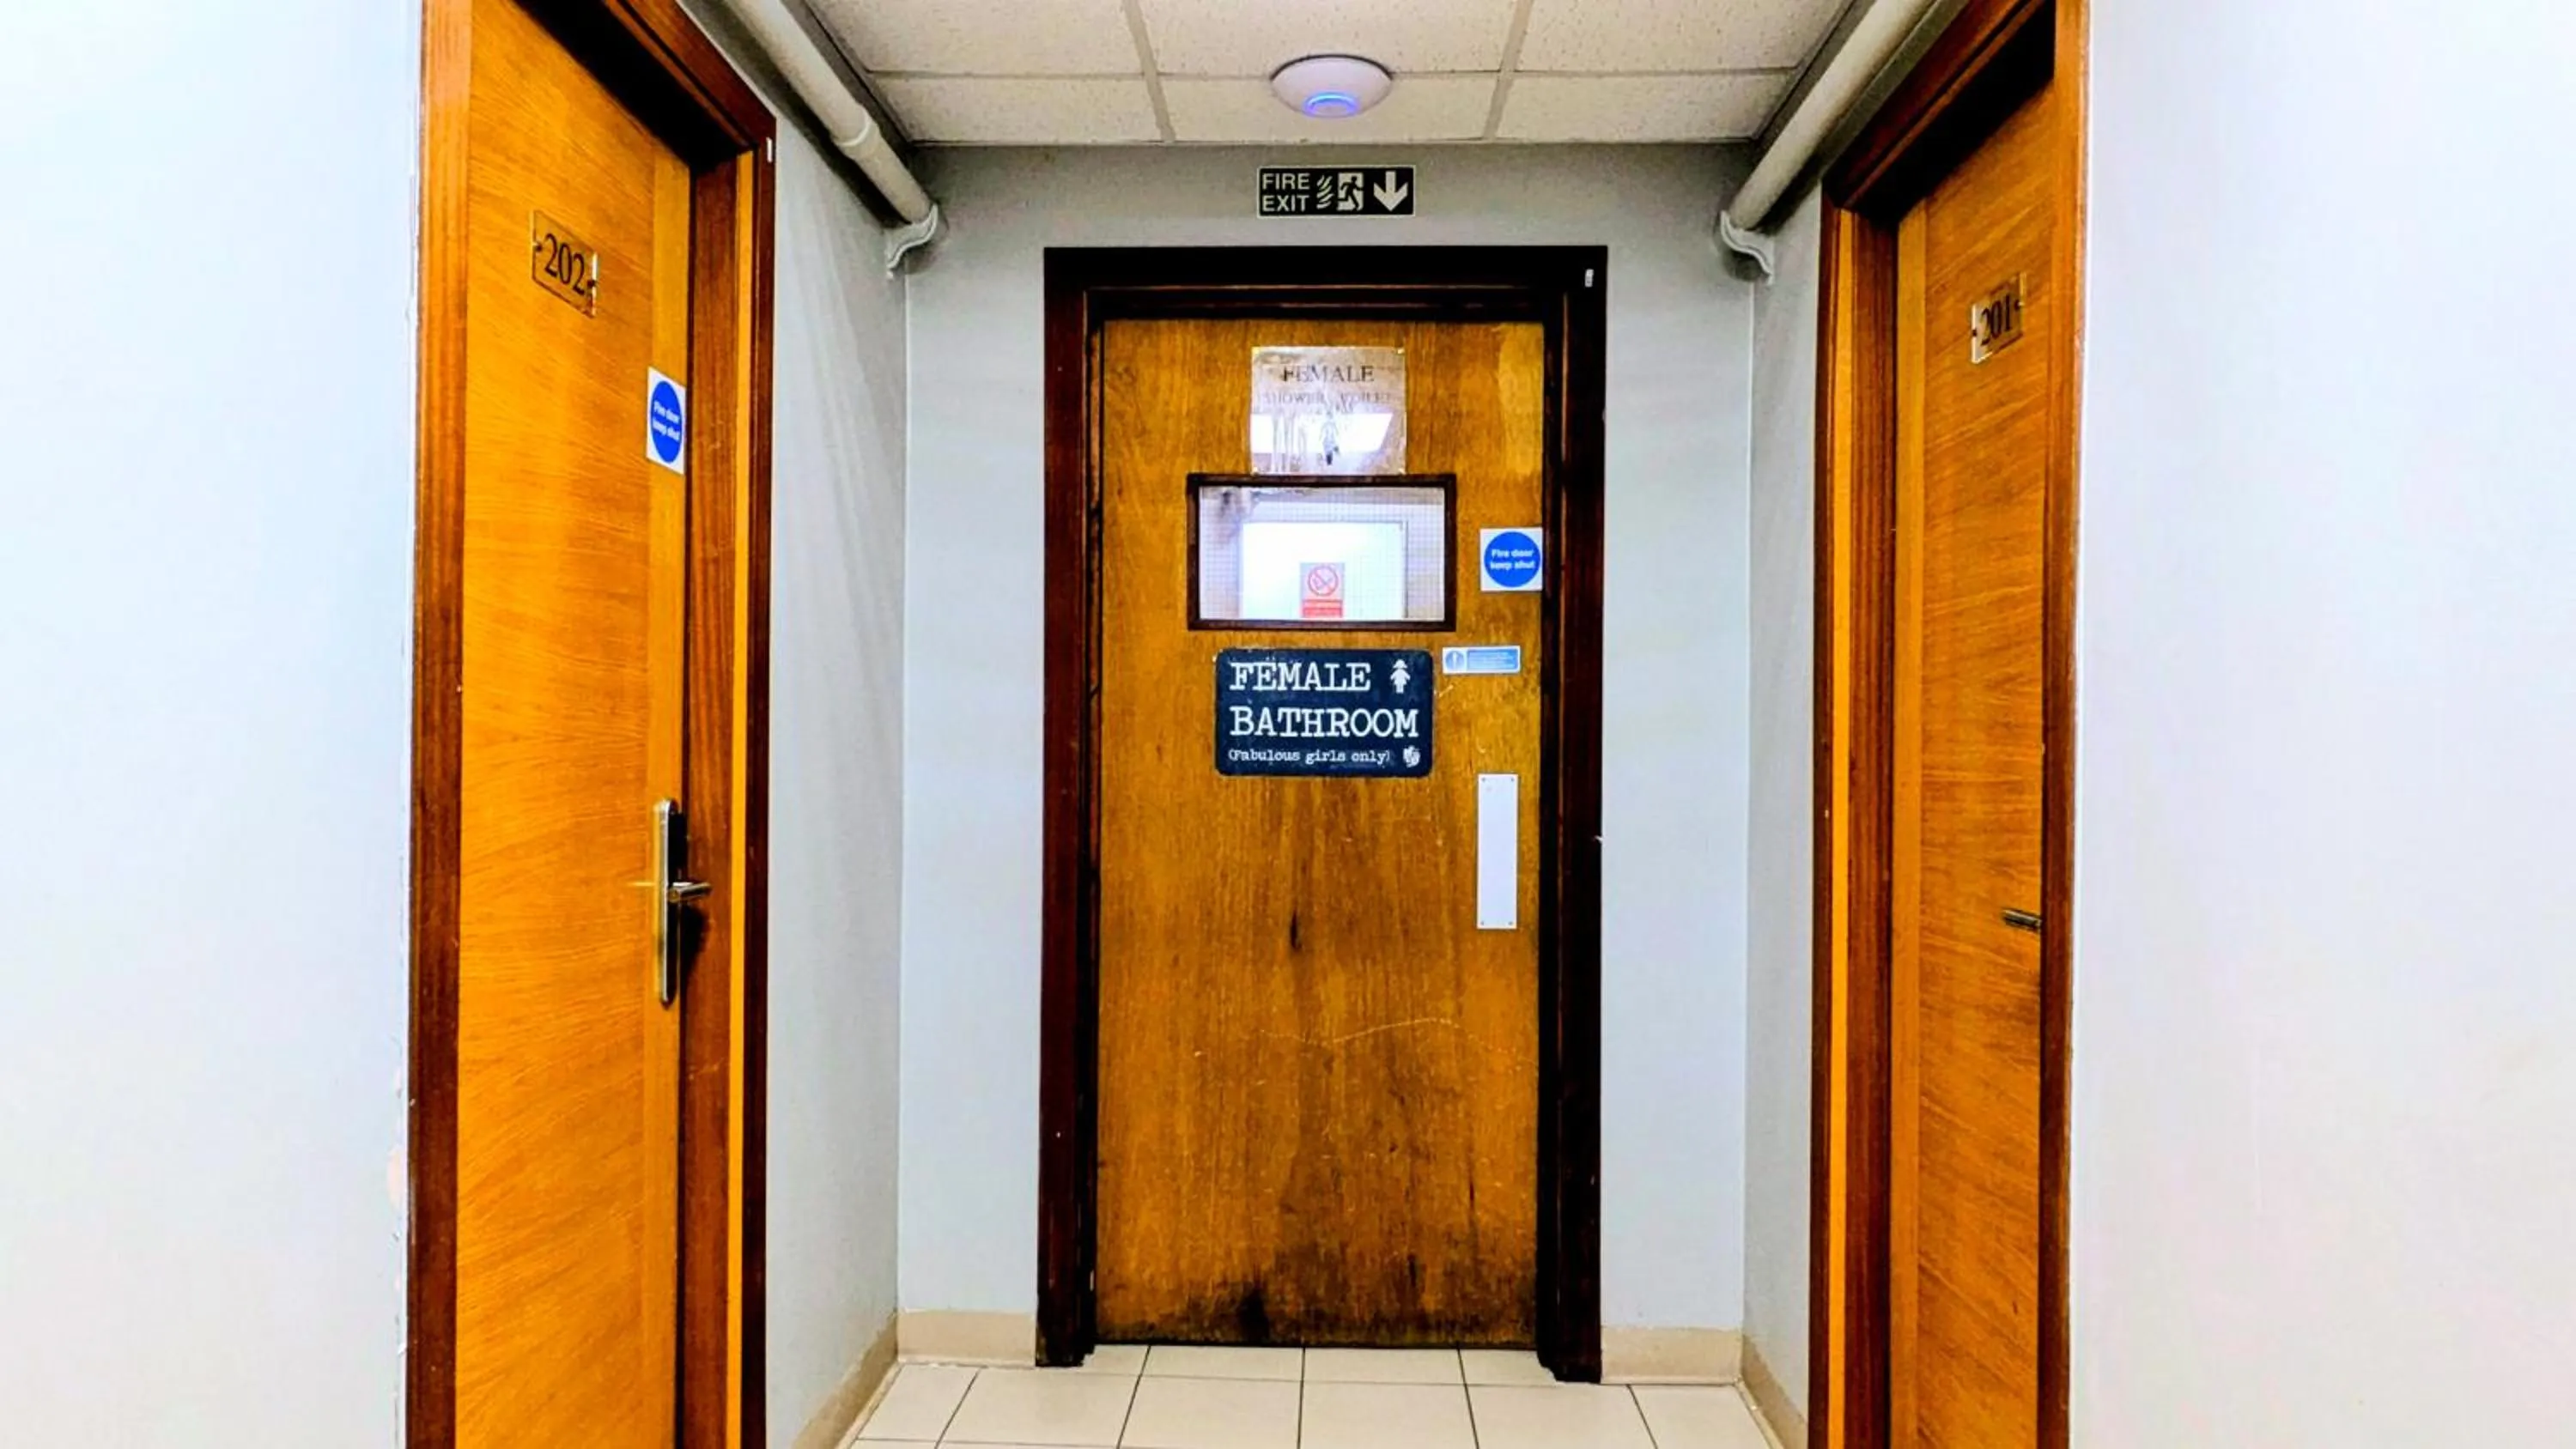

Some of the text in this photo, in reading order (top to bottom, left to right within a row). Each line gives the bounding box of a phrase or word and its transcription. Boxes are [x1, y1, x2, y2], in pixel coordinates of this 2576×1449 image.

[1261, 173, 1310, 190] FIRE
[1261, 194, 1310, 212] EXIT
[544, 232, 586, 296] 202
[1980, 294, 2013, 347] 201
[1282, 365, 1375, 383] FEMALE
[1492, 549, 1534, 558] Fire door
[1229, 661, 1371, 692] FEMALE
[1229, 705, 1419, 738] BATHROOM
[1228, 749, 1391, 766] (Fabulous girls only)
